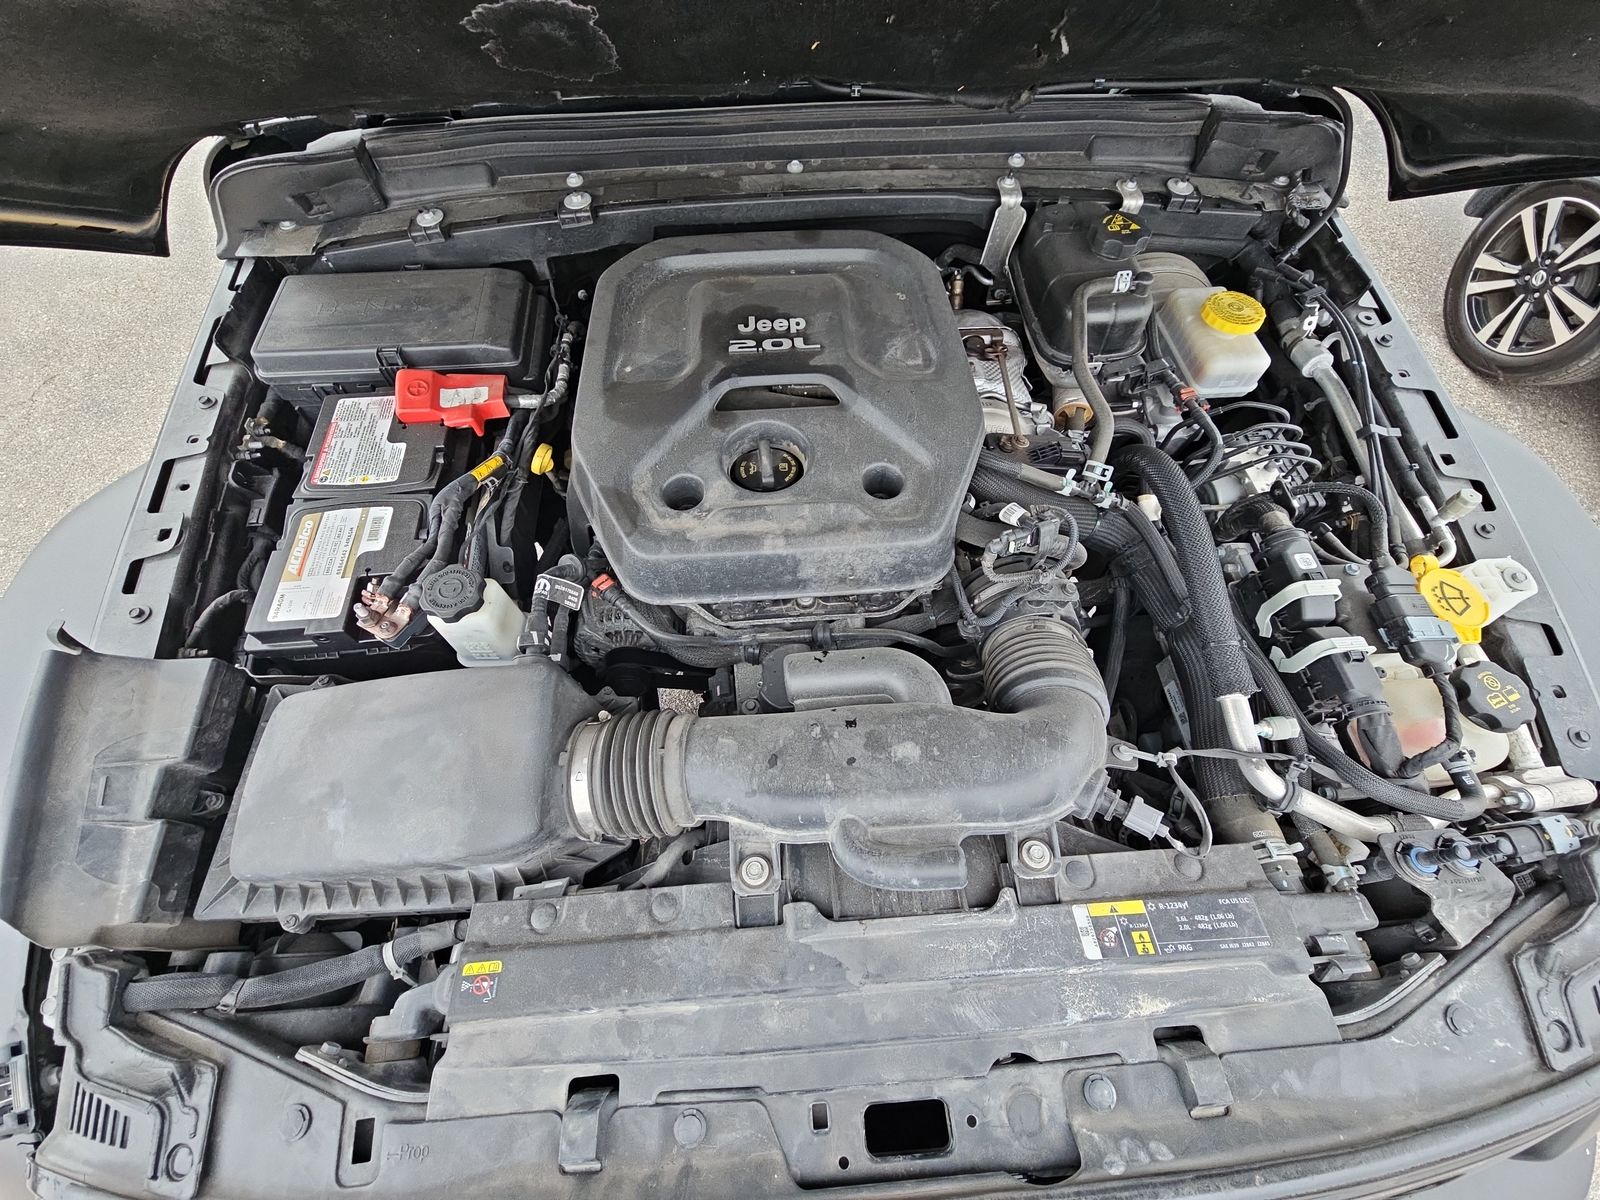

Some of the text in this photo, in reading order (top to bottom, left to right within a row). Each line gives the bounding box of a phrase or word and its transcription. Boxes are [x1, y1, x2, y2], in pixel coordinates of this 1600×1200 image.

[737, 315, 807, 334] Jeep
[728, 337, 821, 353] 2.0L
[287, 520, 314, 576] ACDelco
[1158, 901, 1189, 910] R-1234yf
[1177, 943, 1193, 952] PAG
[399, 1143, 430, 1165] Prop
